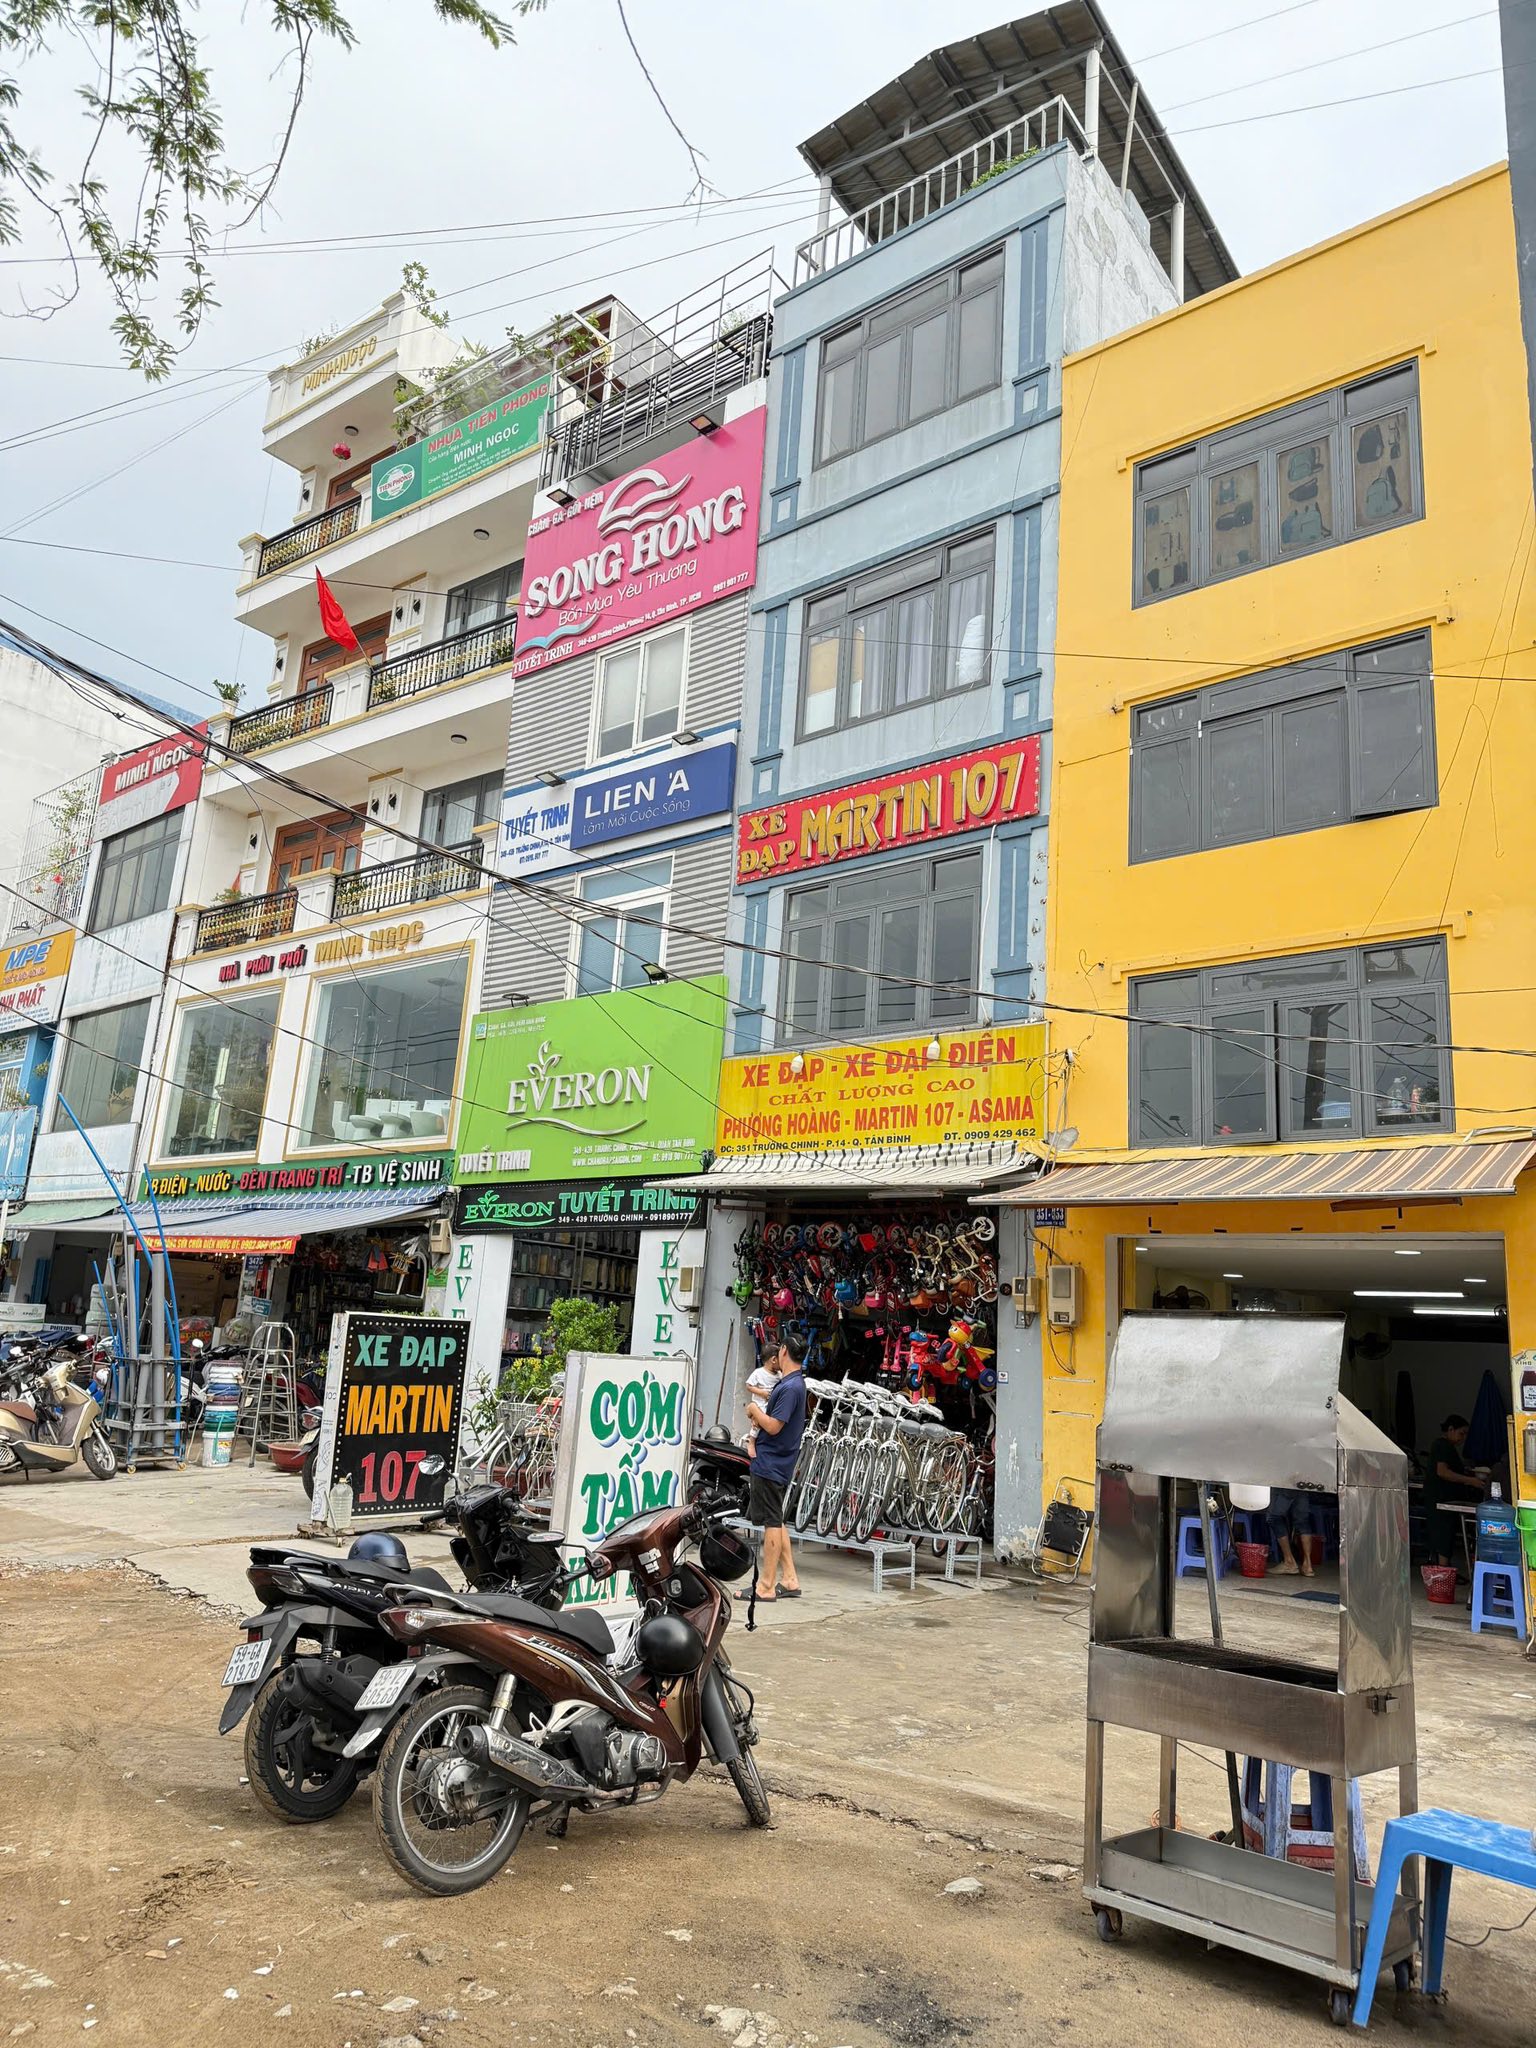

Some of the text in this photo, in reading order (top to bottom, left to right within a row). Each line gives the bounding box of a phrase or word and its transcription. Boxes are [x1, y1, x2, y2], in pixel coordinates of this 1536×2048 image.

[502, 383, 549, 418] PHONG
[454, 423, 520, 464] MINH NGỌC
[524, 485, 747, 618] SONG HONG
[559, 558, 697, 627] Bốn Mùa Yêu Thương
[513, 641, 574, 674] TUYẾT TRINH
[115, 760, 151, 793] MINH
[583, 821, 605, 836] Làm
[630, 807, 659, 824] Cuộc
[661, 796, 691, 815] Sống
[584, 777, 656, 819] LIEN
[748, 752, 1025, 861] XE MARTIN 107
[505, 802, 570, 841] TUYẾT TRINH
[740, 839, 796, 874] ĐẠP
[5, 939, 54, 972] MPE
[219, 920, 424, 982] NHÀ PHÂN PHỐI MINH NGỌC
[742, 1064, 770, 1088] XE
[778, 1058, 824, 1090] ĐẠP
[844, 1052, 876, 1079] XE
[948, 1032, 1016, 1073] ĐIỆN
[507, 1063, 653, 1115] EVERON
[769, 1078, 975, 1106] CHẤT LƯỢNG CAO
[723, 1111, 782, 1144] PHƯỢNG
[787, 1106, 841, 1136] HOÀNG
[854, 1103, 918, 1132] MARTIN
[924, 1102, 954, 1127] 107
[968, 1095, 1034, 1124] ASAMA
[459, 1145, 531, 1174] TUYẾT TRINH
[720, 1145, 734, 1153] ĐC:
[736, 1144, 751, 1152] 351
[753, 1141, 788, 1151] TRƯỜNG
[790, 1140, 819, 1150] CHINH
[826, 1139, 846, 1148] P.14
[852, 1138, 862, 1146] Q.
[865, 1134, 884, 1145] TÂN
[886, 1133, 911, 1144] BÌNH
[944, 1132, 961, 1141] ĐT.
[964, 1131, 990, 1140] 0909
[993, 1129, 1013, 1138] 429
[1015, 1127, 1036, 1137] 462
[159, 1174, 188, 1197] ĐIỆN
[196, 1170, 231, 1192] NƯỚC
[239, 1169, 268, 1191] ĐÈN
[270, 1167, 315, 1189] TRANG
[319, 1164, 344, 1186] TRÍ
[378, 1159, 398, 1186] VỆ
[401, 1160, 441, 1181] SINH
[464, 1183, 697, 1219] EVERON TUYẾT TRINH
[575, 1215, 588, 1223] 439
[589, 1212, 619, 1223] TRƯỜNG
[620, 1213, 644, 1221] CHINH
[649, 1212, 693, 1221] 0918901777
[653, 1241, 679, 1357] EVE
[354, 1334, 457, 1374] XE ĐẠP
[345, 1385, 454, 1436] MARTIN
[590, 1370, 684, 1447] CƠM
[359, 1450, 427, 1503] 107
[581, 1443, 677, 1536] TẤM
[224, 1661, 259, 1684] 219.78
